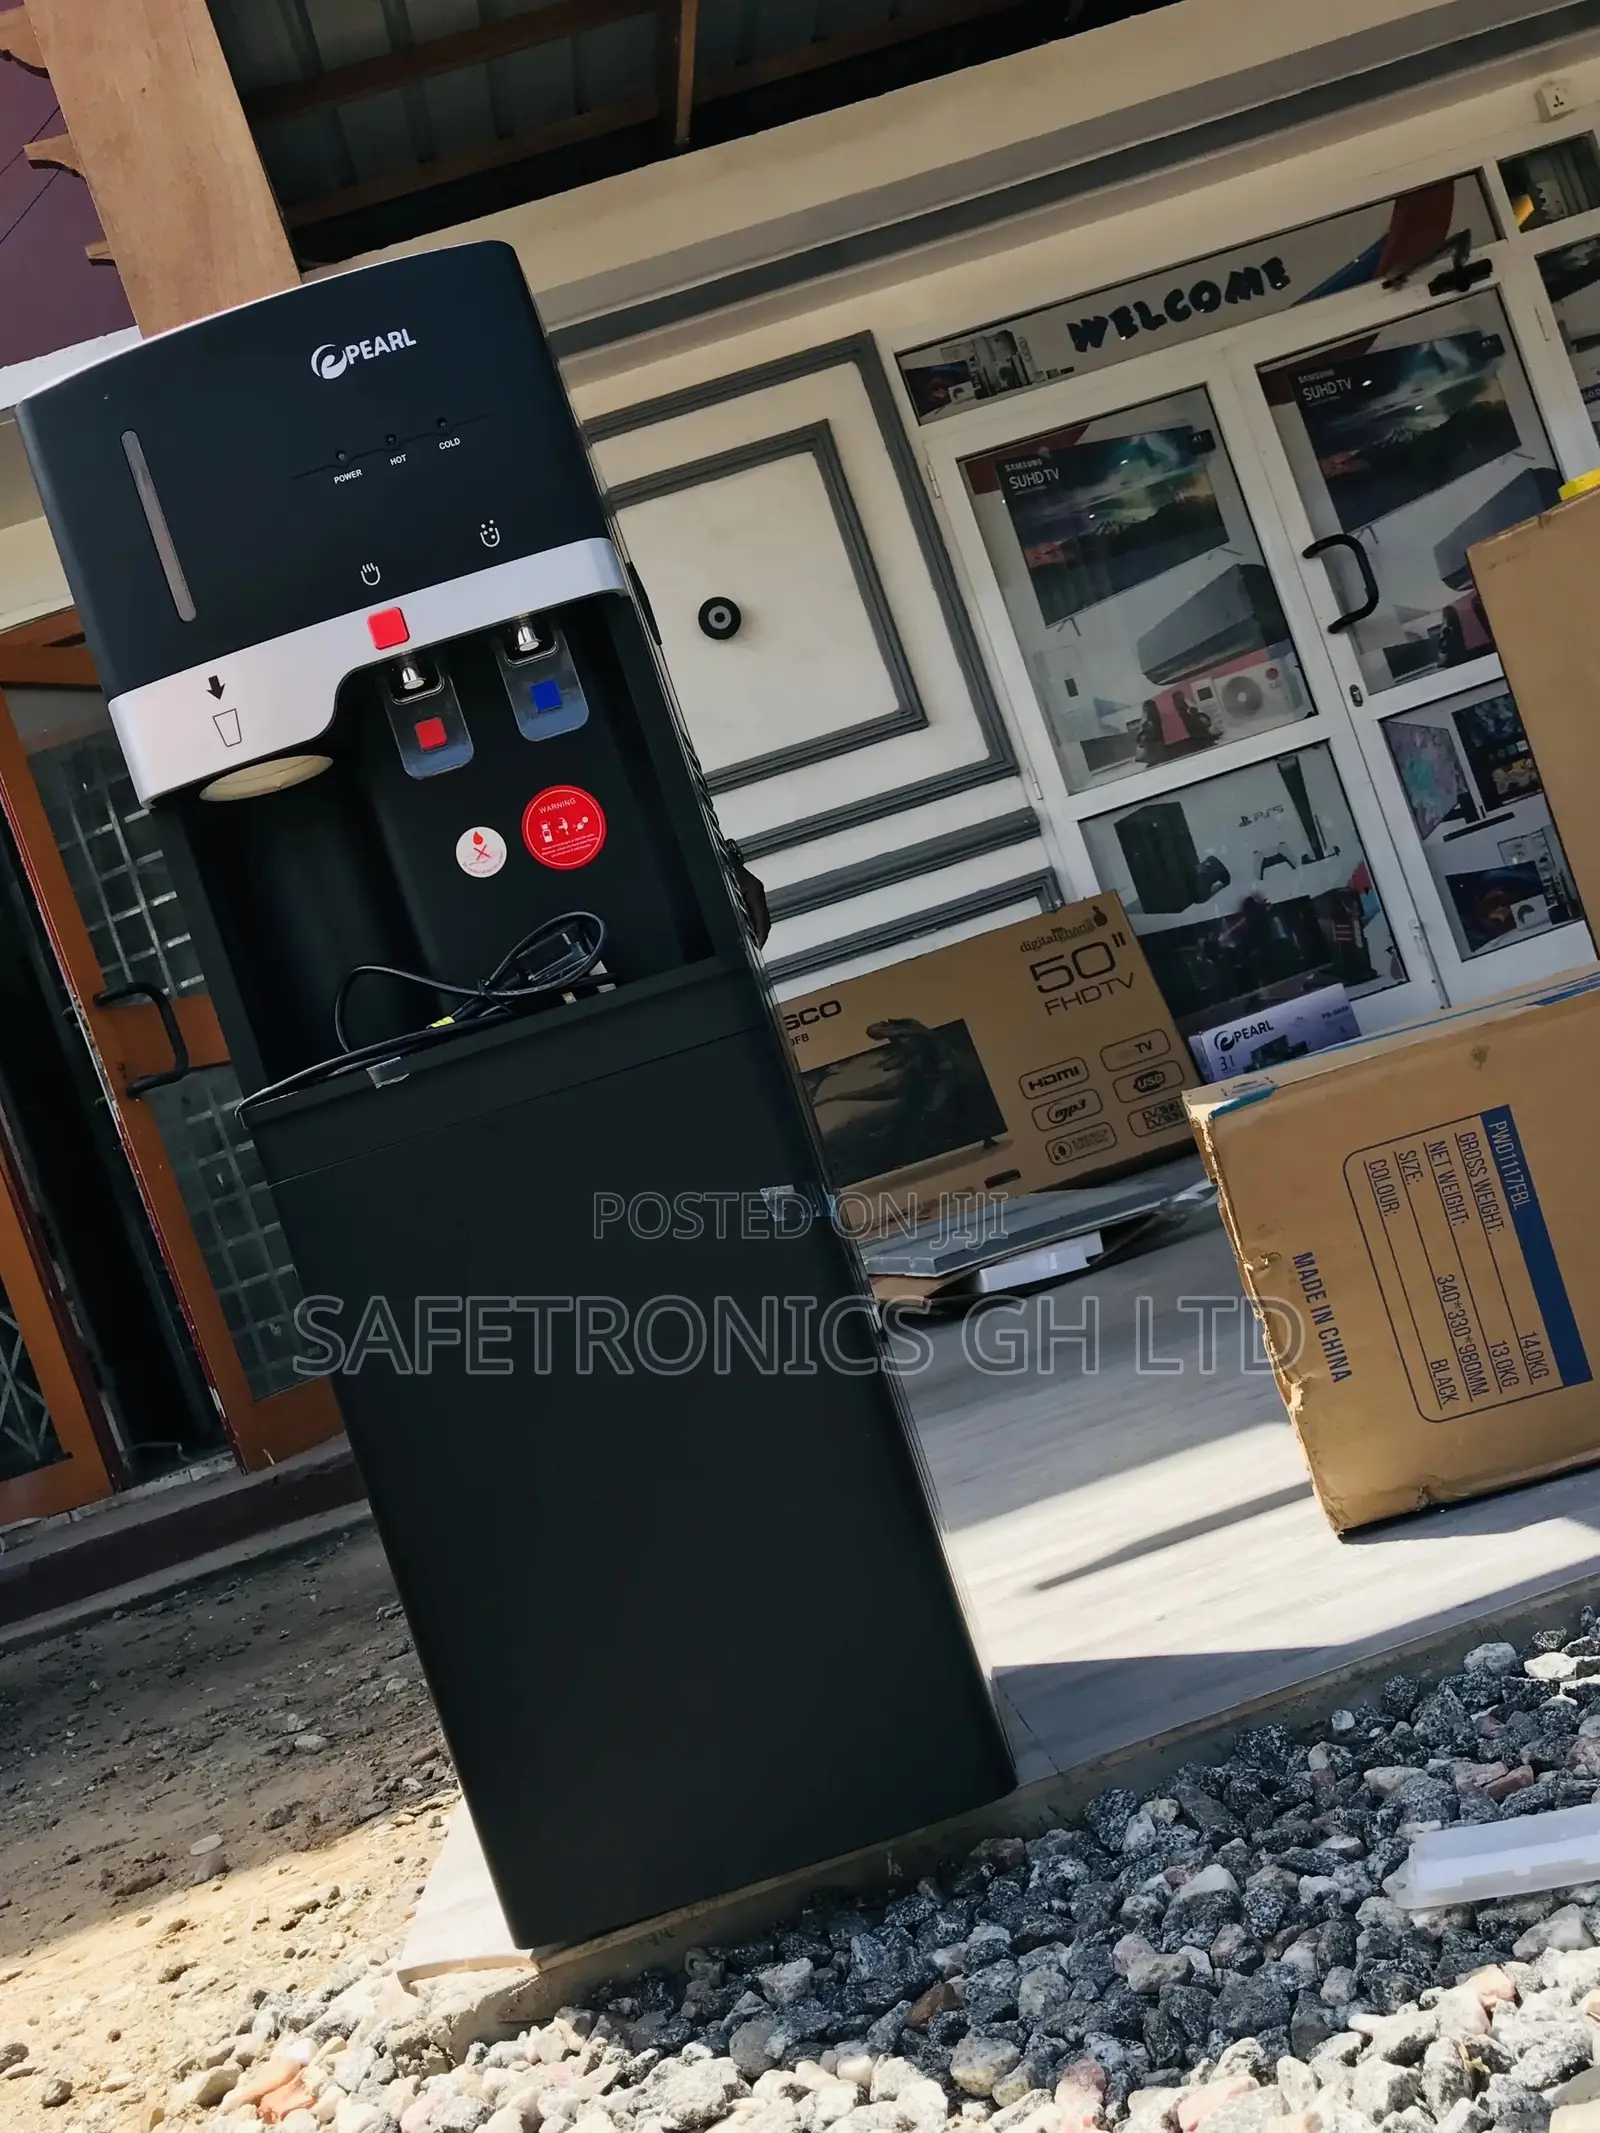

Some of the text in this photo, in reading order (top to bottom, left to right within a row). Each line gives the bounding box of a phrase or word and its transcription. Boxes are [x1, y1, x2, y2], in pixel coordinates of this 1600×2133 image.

[1066, 256, 1291, 353] WELCOME
[345, 328, 417, 365] PEARL
[389, 453, 408, 466] HOT
[438, 437, 461, 450] COLD
[333, 469, 363, 485] POWER
[538, 797, 577, 814] WARNING
[1044, 971, 1135, 1016] FHDTV
[1134, 1039, 1153, 1054] TV
[1233, 1019, 1275, 1044] PEARL
[1028, 1065, 1080, 1092] HDMI
[1398, 1149, 1424, 1186] SIZE:
[1488, 1120, 1532, 1212] PWD1117FBL
[1427, 1140, 1520, 1388] NET WEIGHT: 13.0KG
[1458, 1131, 1550, 1380] GROSS WEIGHT: 14.0KG
[1368, 1158, 1461, 1405] COLOUR: BLACK
[1292, 1251, 1353, 1384] MADE IN CHINA
